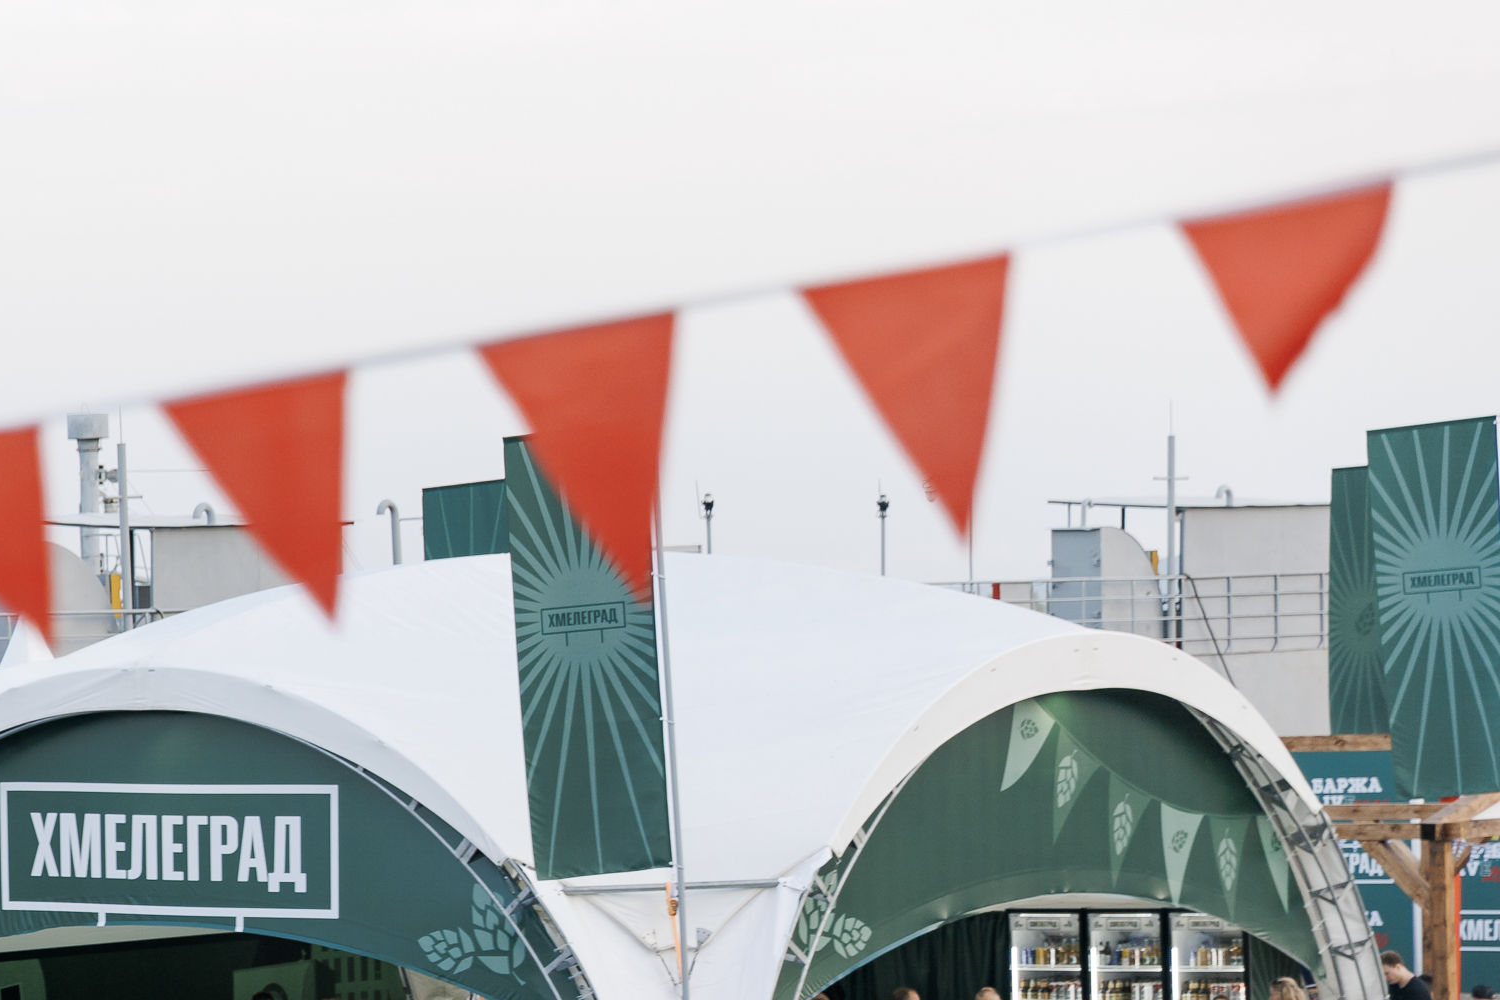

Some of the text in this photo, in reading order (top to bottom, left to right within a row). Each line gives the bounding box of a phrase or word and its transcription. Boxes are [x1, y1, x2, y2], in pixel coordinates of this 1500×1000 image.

[1410, 571, 1475, 588] ХМЕЛЕГРАД
[548, 608, 618, 628] ХМЕЛЕГРАД
[1311, 776, 1383, 794] БАРЖА
[30, 812, 307, 893] ХМЕЛЕГРАД
